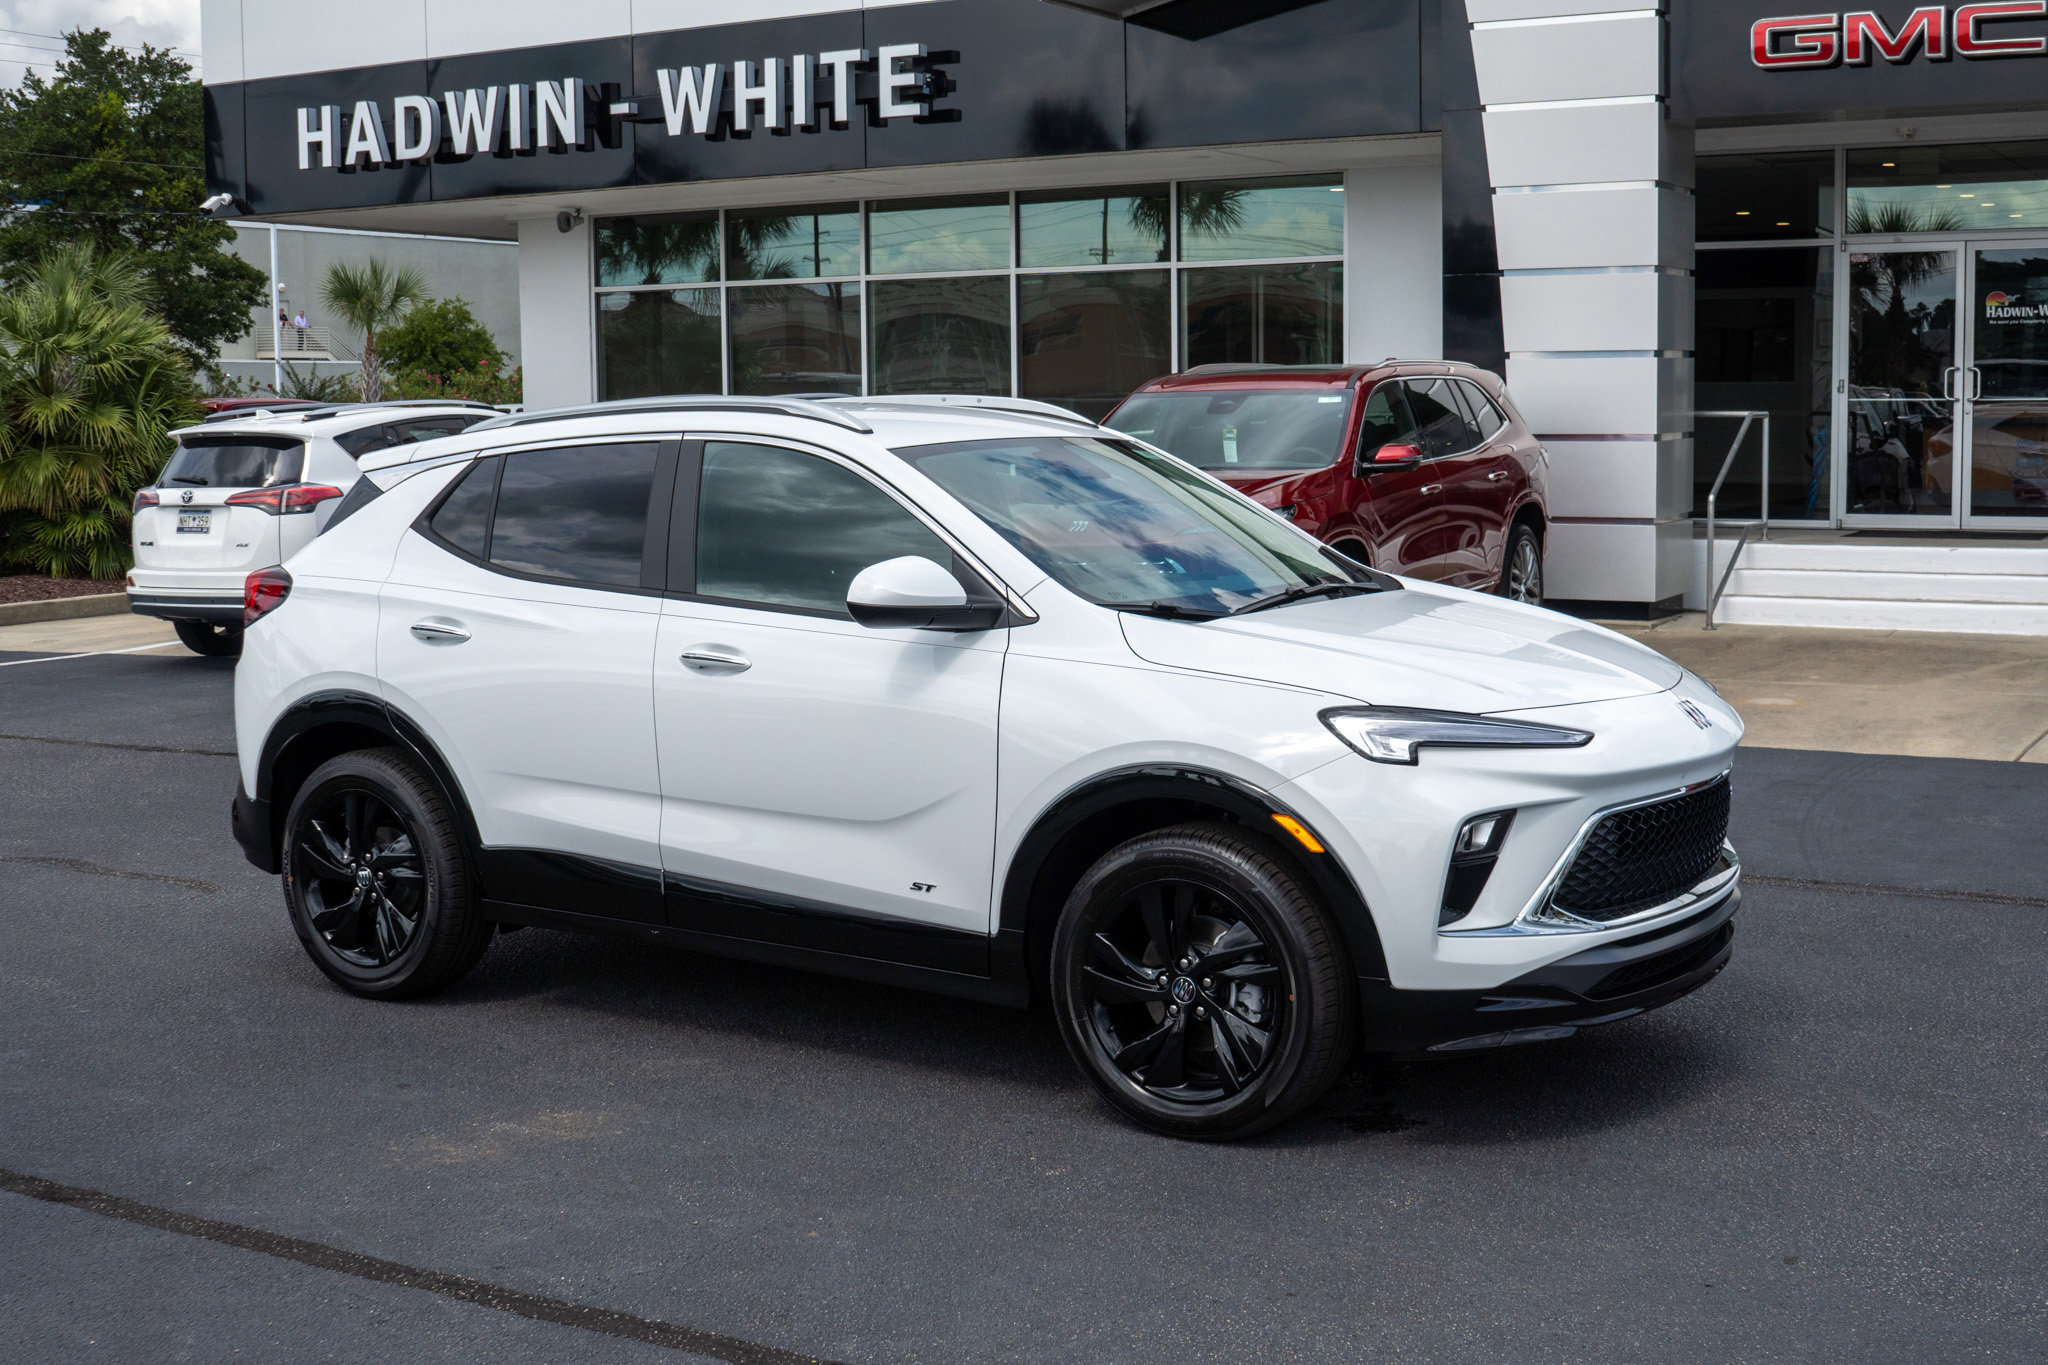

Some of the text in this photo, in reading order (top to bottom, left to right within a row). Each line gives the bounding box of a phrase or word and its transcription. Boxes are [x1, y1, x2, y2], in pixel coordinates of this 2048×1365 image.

[1750, 0, 2047, 69] GMC
[297, 76, 585, 170] HADWIN
[656, 42, 928, 137] WHITE
[910, 881, 938, 893] ST
